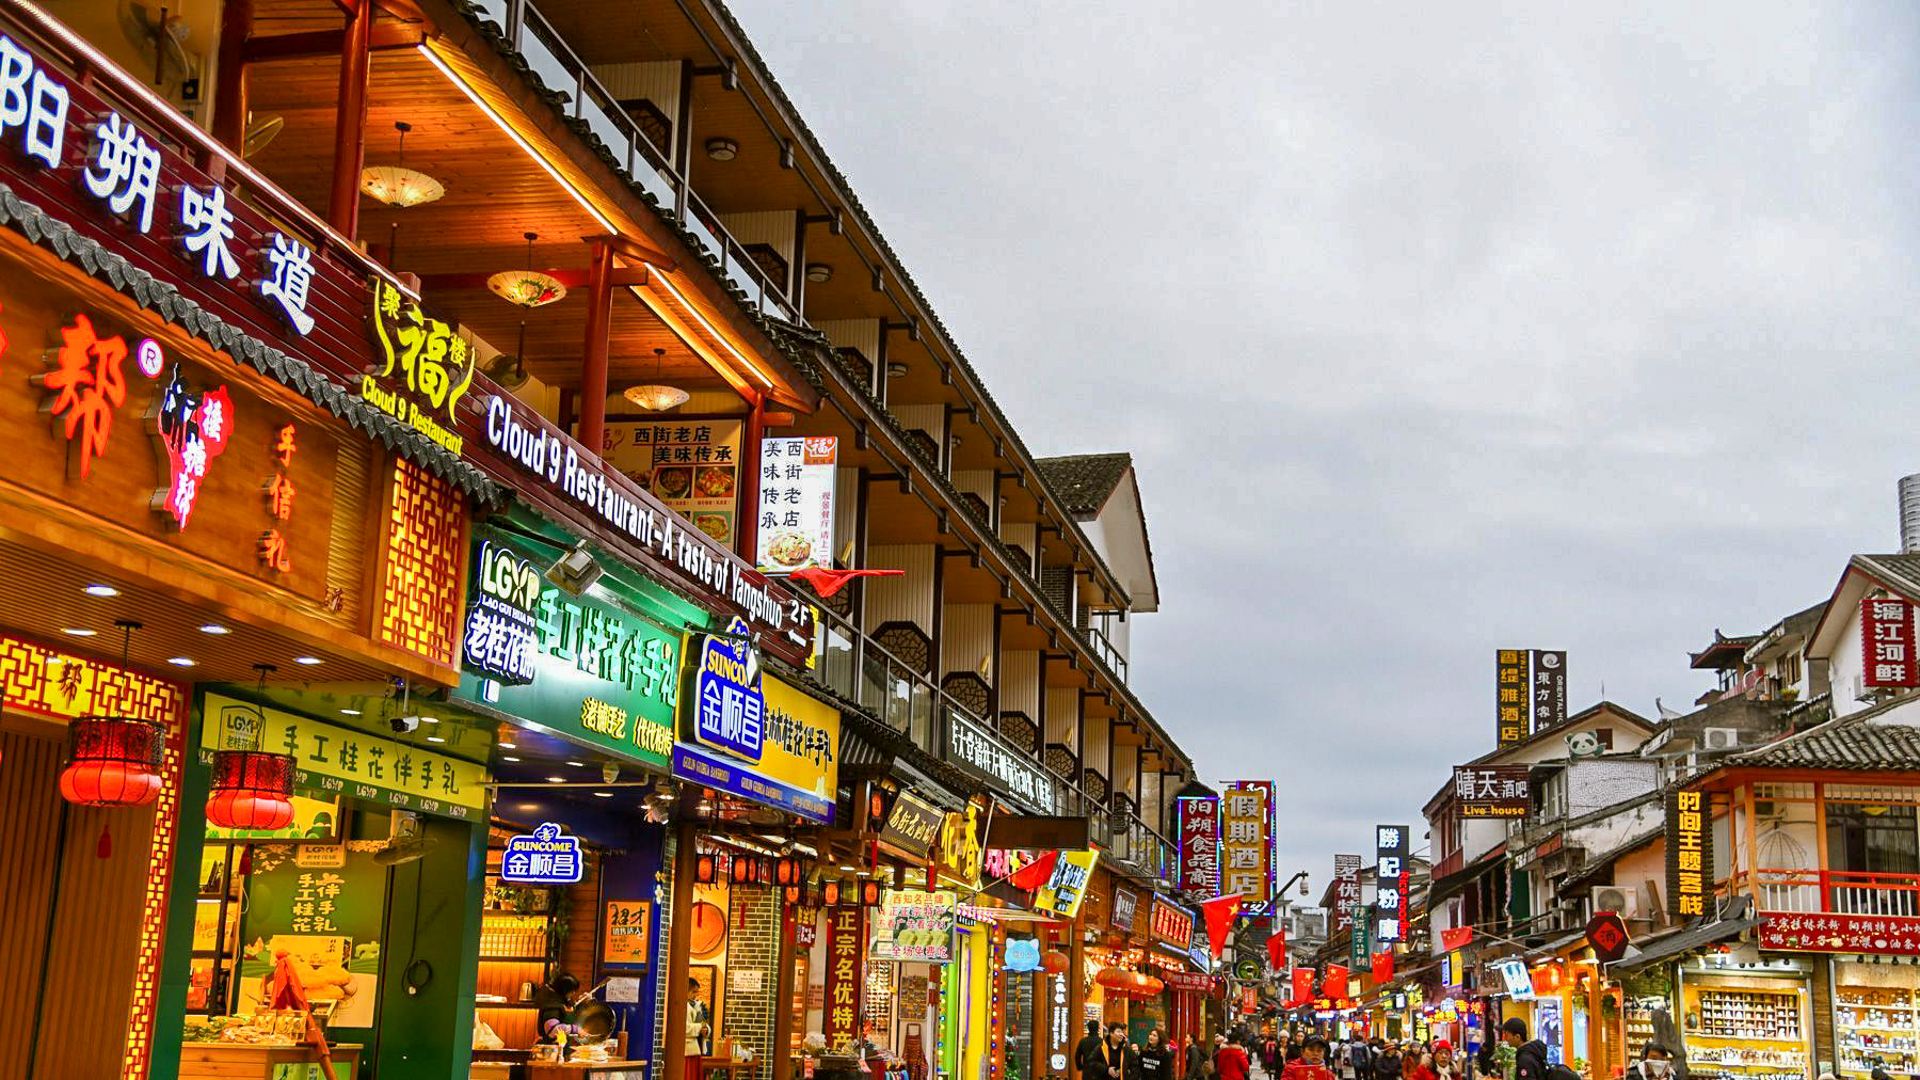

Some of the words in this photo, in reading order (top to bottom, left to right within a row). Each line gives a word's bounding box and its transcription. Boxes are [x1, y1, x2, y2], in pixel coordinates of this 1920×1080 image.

[0, 34, 317, 336] 阳朔味道
[362, 374, 397, 417] Cloud
[397, 397, 407, 421] 9
[408, 402, 463, 457] Restaurant
[634, 426, 712, 444] 西街老店
[654, 445, 733, 463] 美味传承
[761, 441, 782, 529] 美味传承
[783, 440, 803, 527] 西街老店
[264, 423, 297, 572] 手信礼
[486, 395, 546, 482] Cloud
[547, 441, 563, 489] 9
[677, 530, 713, 590] taste
[714, 558, 729, 593] of
[730, 562, 784, 630] Yangshuo
[482, 594, 499, 610] LAO
[790, 601, 811, 627] 2F
[468, 608, 537, 680] 老桂花铺
[536, 589, 677, 708] 手工桂花伴手礼
[707, 650, 759, 694] SUNCO
[1873, 602, 1906, 682] 漓江河鲜
[701, 679, 761, 751] 金顺昌
[1556, 675, 1564, 711] ORIENTAL
[283, 725, 460, 795] 手工桂花伴手礼
[1455, 769, 1528, 799] 晴天酒吧
[1464, 805, 1486, 816] Live
[1490, 805, 1525, 816] house
[507, 853, 576, 877] 金顺昌
[513, 841, 573, 852] SUNCOME
[1229, 795, 1259, 896] 假期酒店
[1678, 791, 1704, 916] 时间主题客栈
[292, 873, 315, 932] 手工桂花
[314, 883, 341, 932] 伴手礼
[1337, 866, 1362, 931] 名优特产
[1767, 917, 1840, 931] 正宗桂林米粉
[1889, 938, 1916, 950] 油条
[832, 911, 857, 1054] 正宗名优特产
